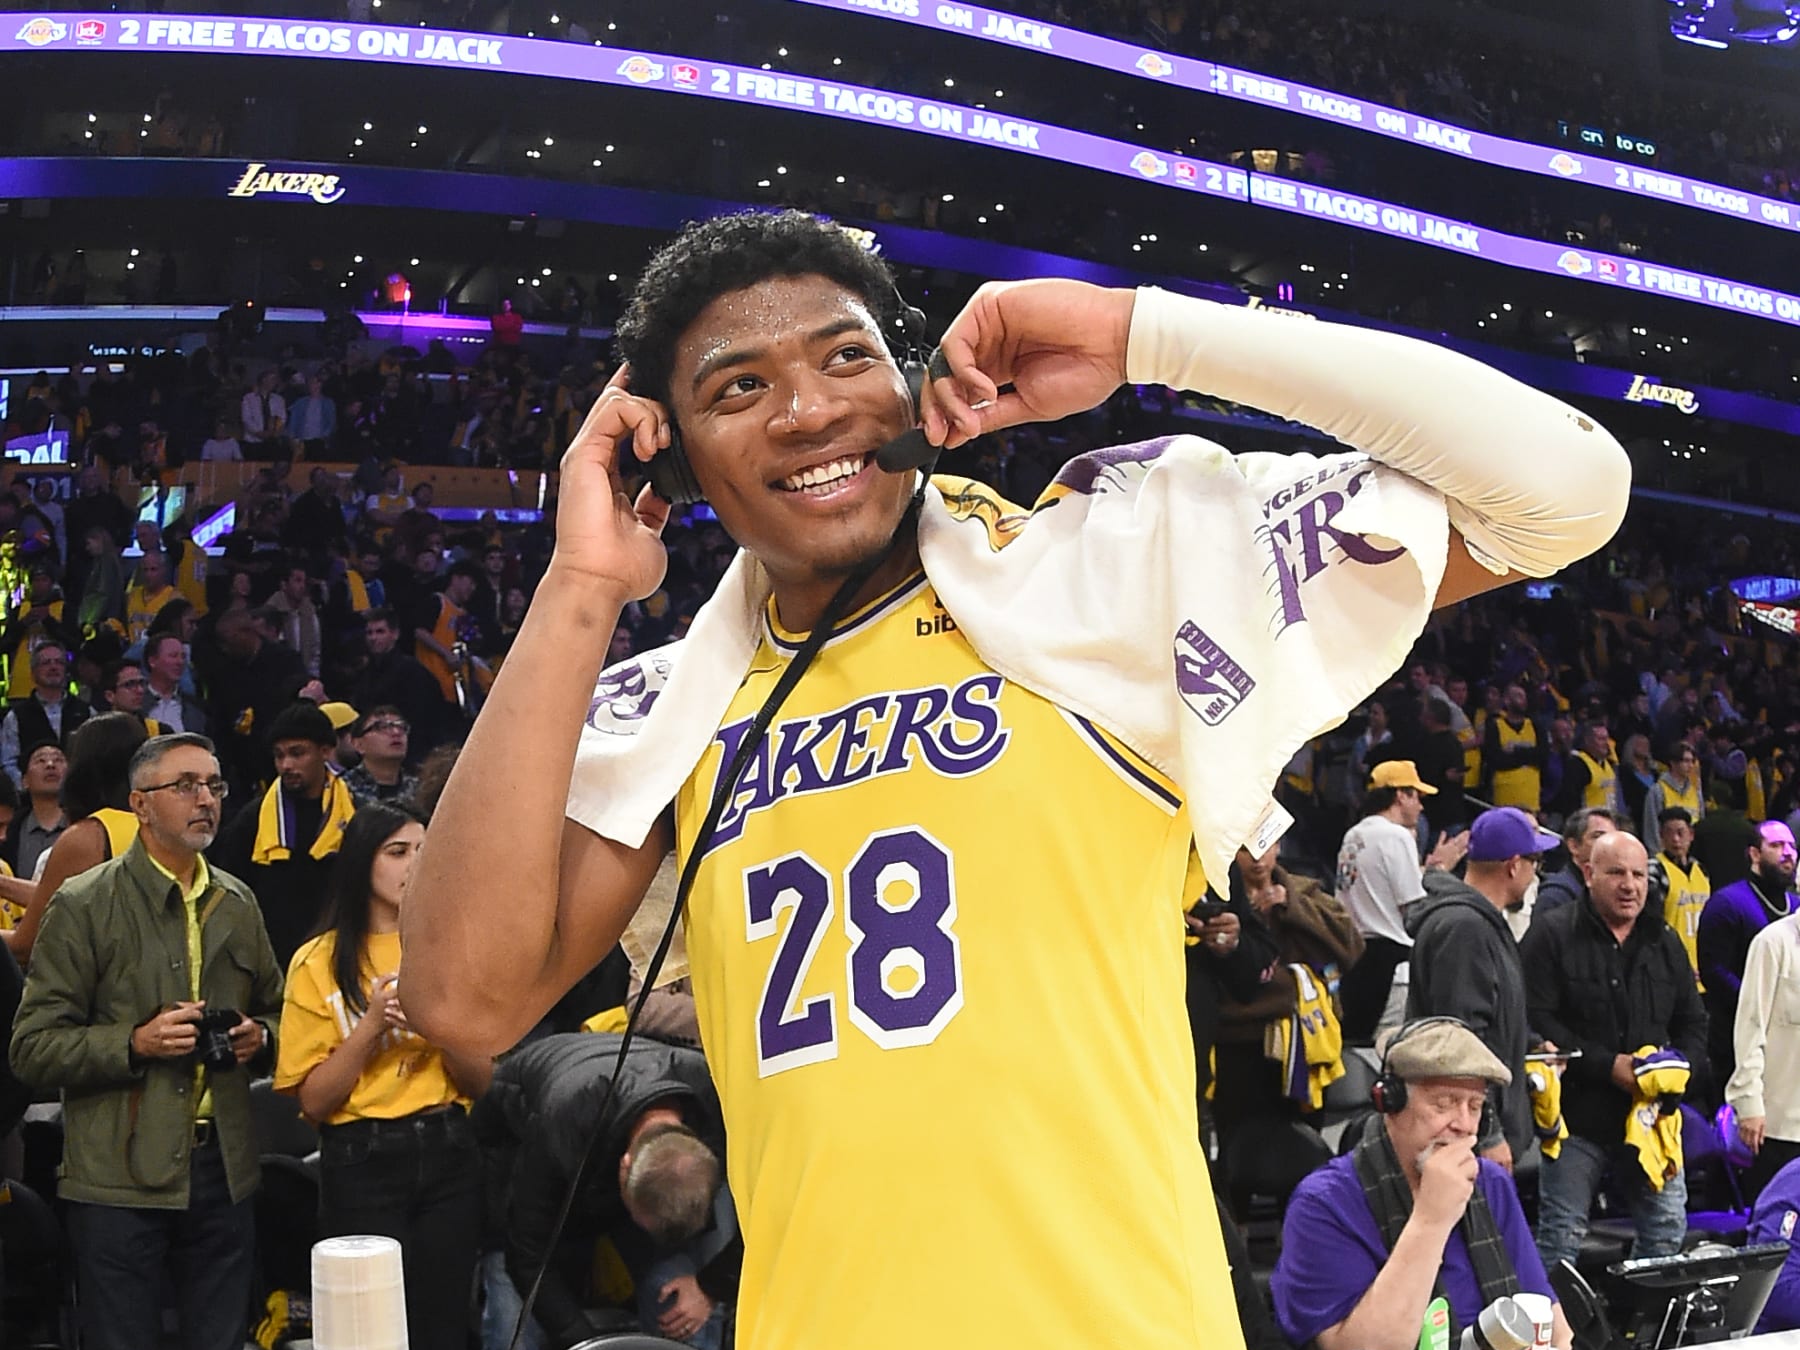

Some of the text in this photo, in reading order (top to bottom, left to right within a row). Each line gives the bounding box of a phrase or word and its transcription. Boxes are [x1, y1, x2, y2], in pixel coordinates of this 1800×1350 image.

[118, 20, 141, 45] 2
[147, 20, 236, 47] FREE
[243, 24, 351, 54] TACOS
[357, 30, 409, 57] ON
[415, 35, 502, 65] JACK
[937, 5, 973, 29] ON
[981, 14, 1053, 49] JACK
[710, 68, 731, 94] 2
[737, 73, 815, 106] FREE
[819, 86, 915, 123] TACOS
[918, 104, 962, 133] ON
[967, 114, 1040, 150] JACK
[1209, 68, 1473, 155] 2 FREE TACOS ON JACK
[227, 163, 346, 204] LAKERS
[1205, 167, 1480, 252] 2 FREE TACOS ON JACK
[1614, 167, 1790, 225] 2 FREE TACOS ON
[1625, 263, 1641, 286] 2
[1643, 267, 1702, 299] FREE
[1704, 279, 1773, 315] TACOS
[1624, 375, 1699, 414] LAKERS
[1204, 697, 1229, 721] NBA
[700, 674, 1013, 860] LAKERS
[742, 824, 964, 1079] 28
